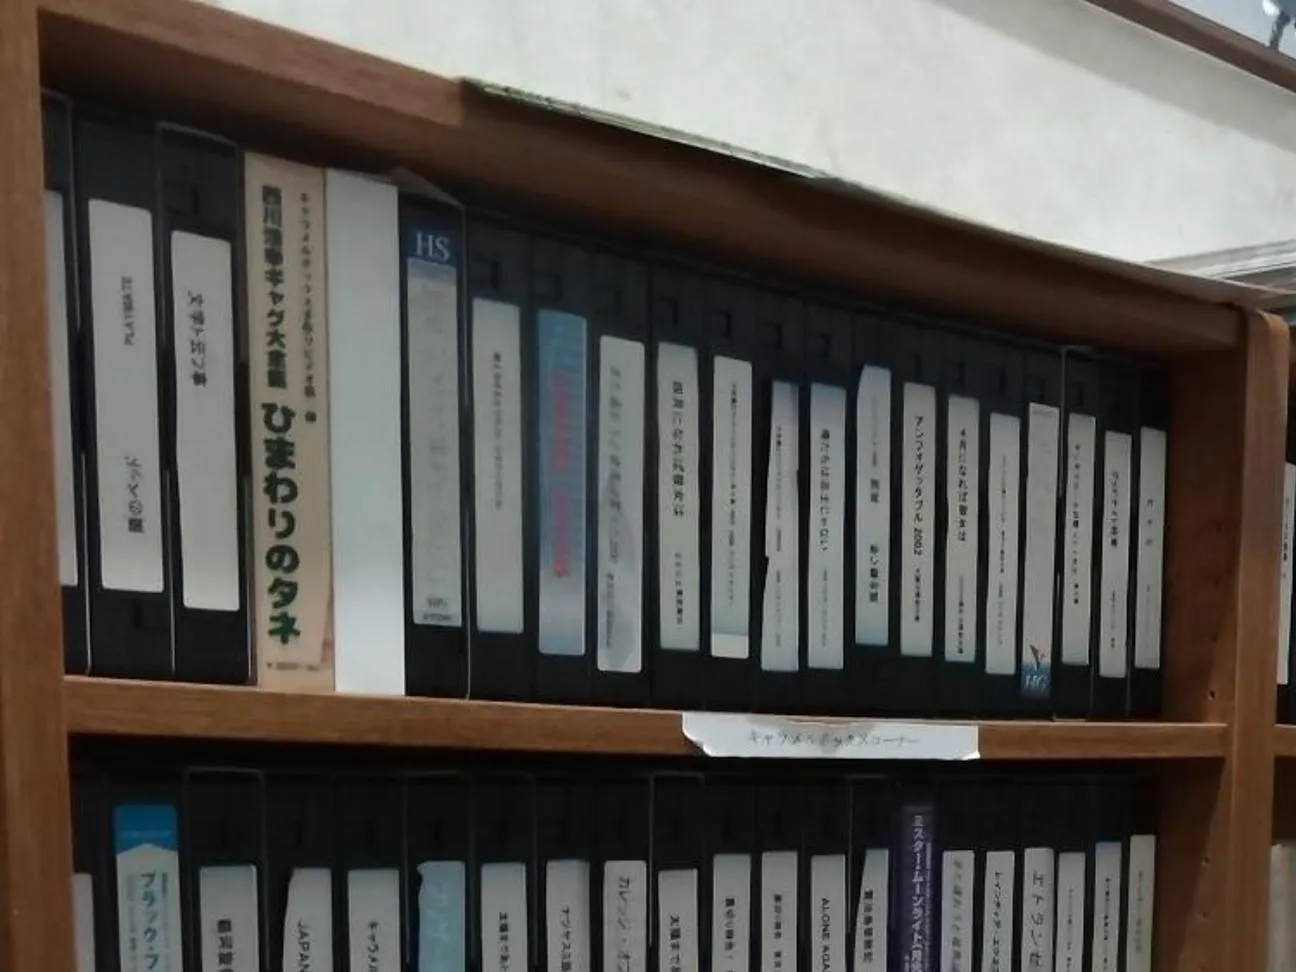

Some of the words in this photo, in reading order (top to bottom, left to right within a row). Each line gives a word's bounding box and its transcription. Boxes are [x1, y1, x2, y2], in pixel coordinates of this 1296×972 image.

[415, 231, 450, 261] HS
[261, 402, 300, 645] ひまわりのタネ
[821, 897, 831, 940] ALONE
